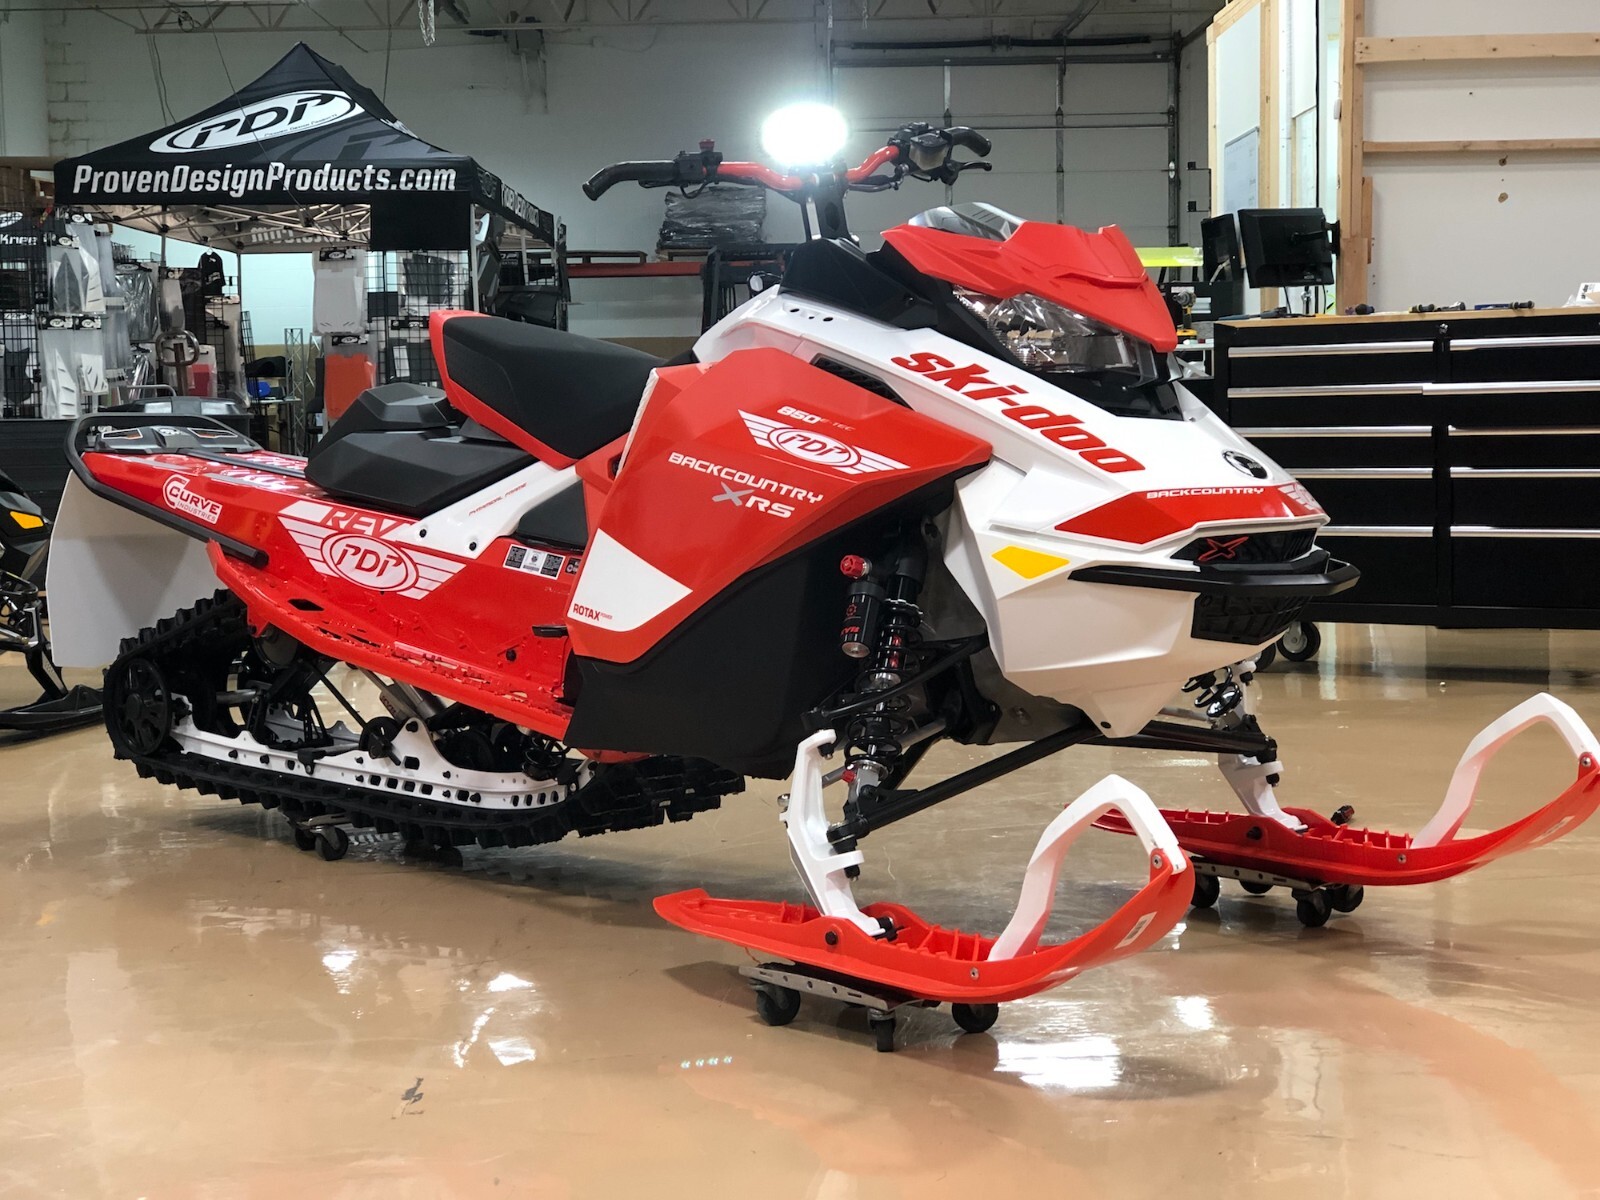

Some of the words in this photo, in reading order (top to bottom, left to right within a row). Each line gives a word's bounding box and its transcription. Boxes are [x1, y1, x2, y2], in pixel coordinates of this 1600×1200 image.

[190, 93, 337, 149] PDP
[73, 161, 456, 198] ProvenDesignProducts.com
[777, 405, 822, 424] 850
[890, 352, 1146, 474] ski-doo
[668, 451, 824, 504] BACKCOUNTRY
[1146, 487, 1265, 499] BACKCOUNTRY
[167, 483, 221, 516] CURVE
[177, 500, 217, 522] INDUSTRIES
[320, 506, 399, 537] REV
[335, 543, 404, 578] PDP
[573, 603, 601, 622] ROTAX
